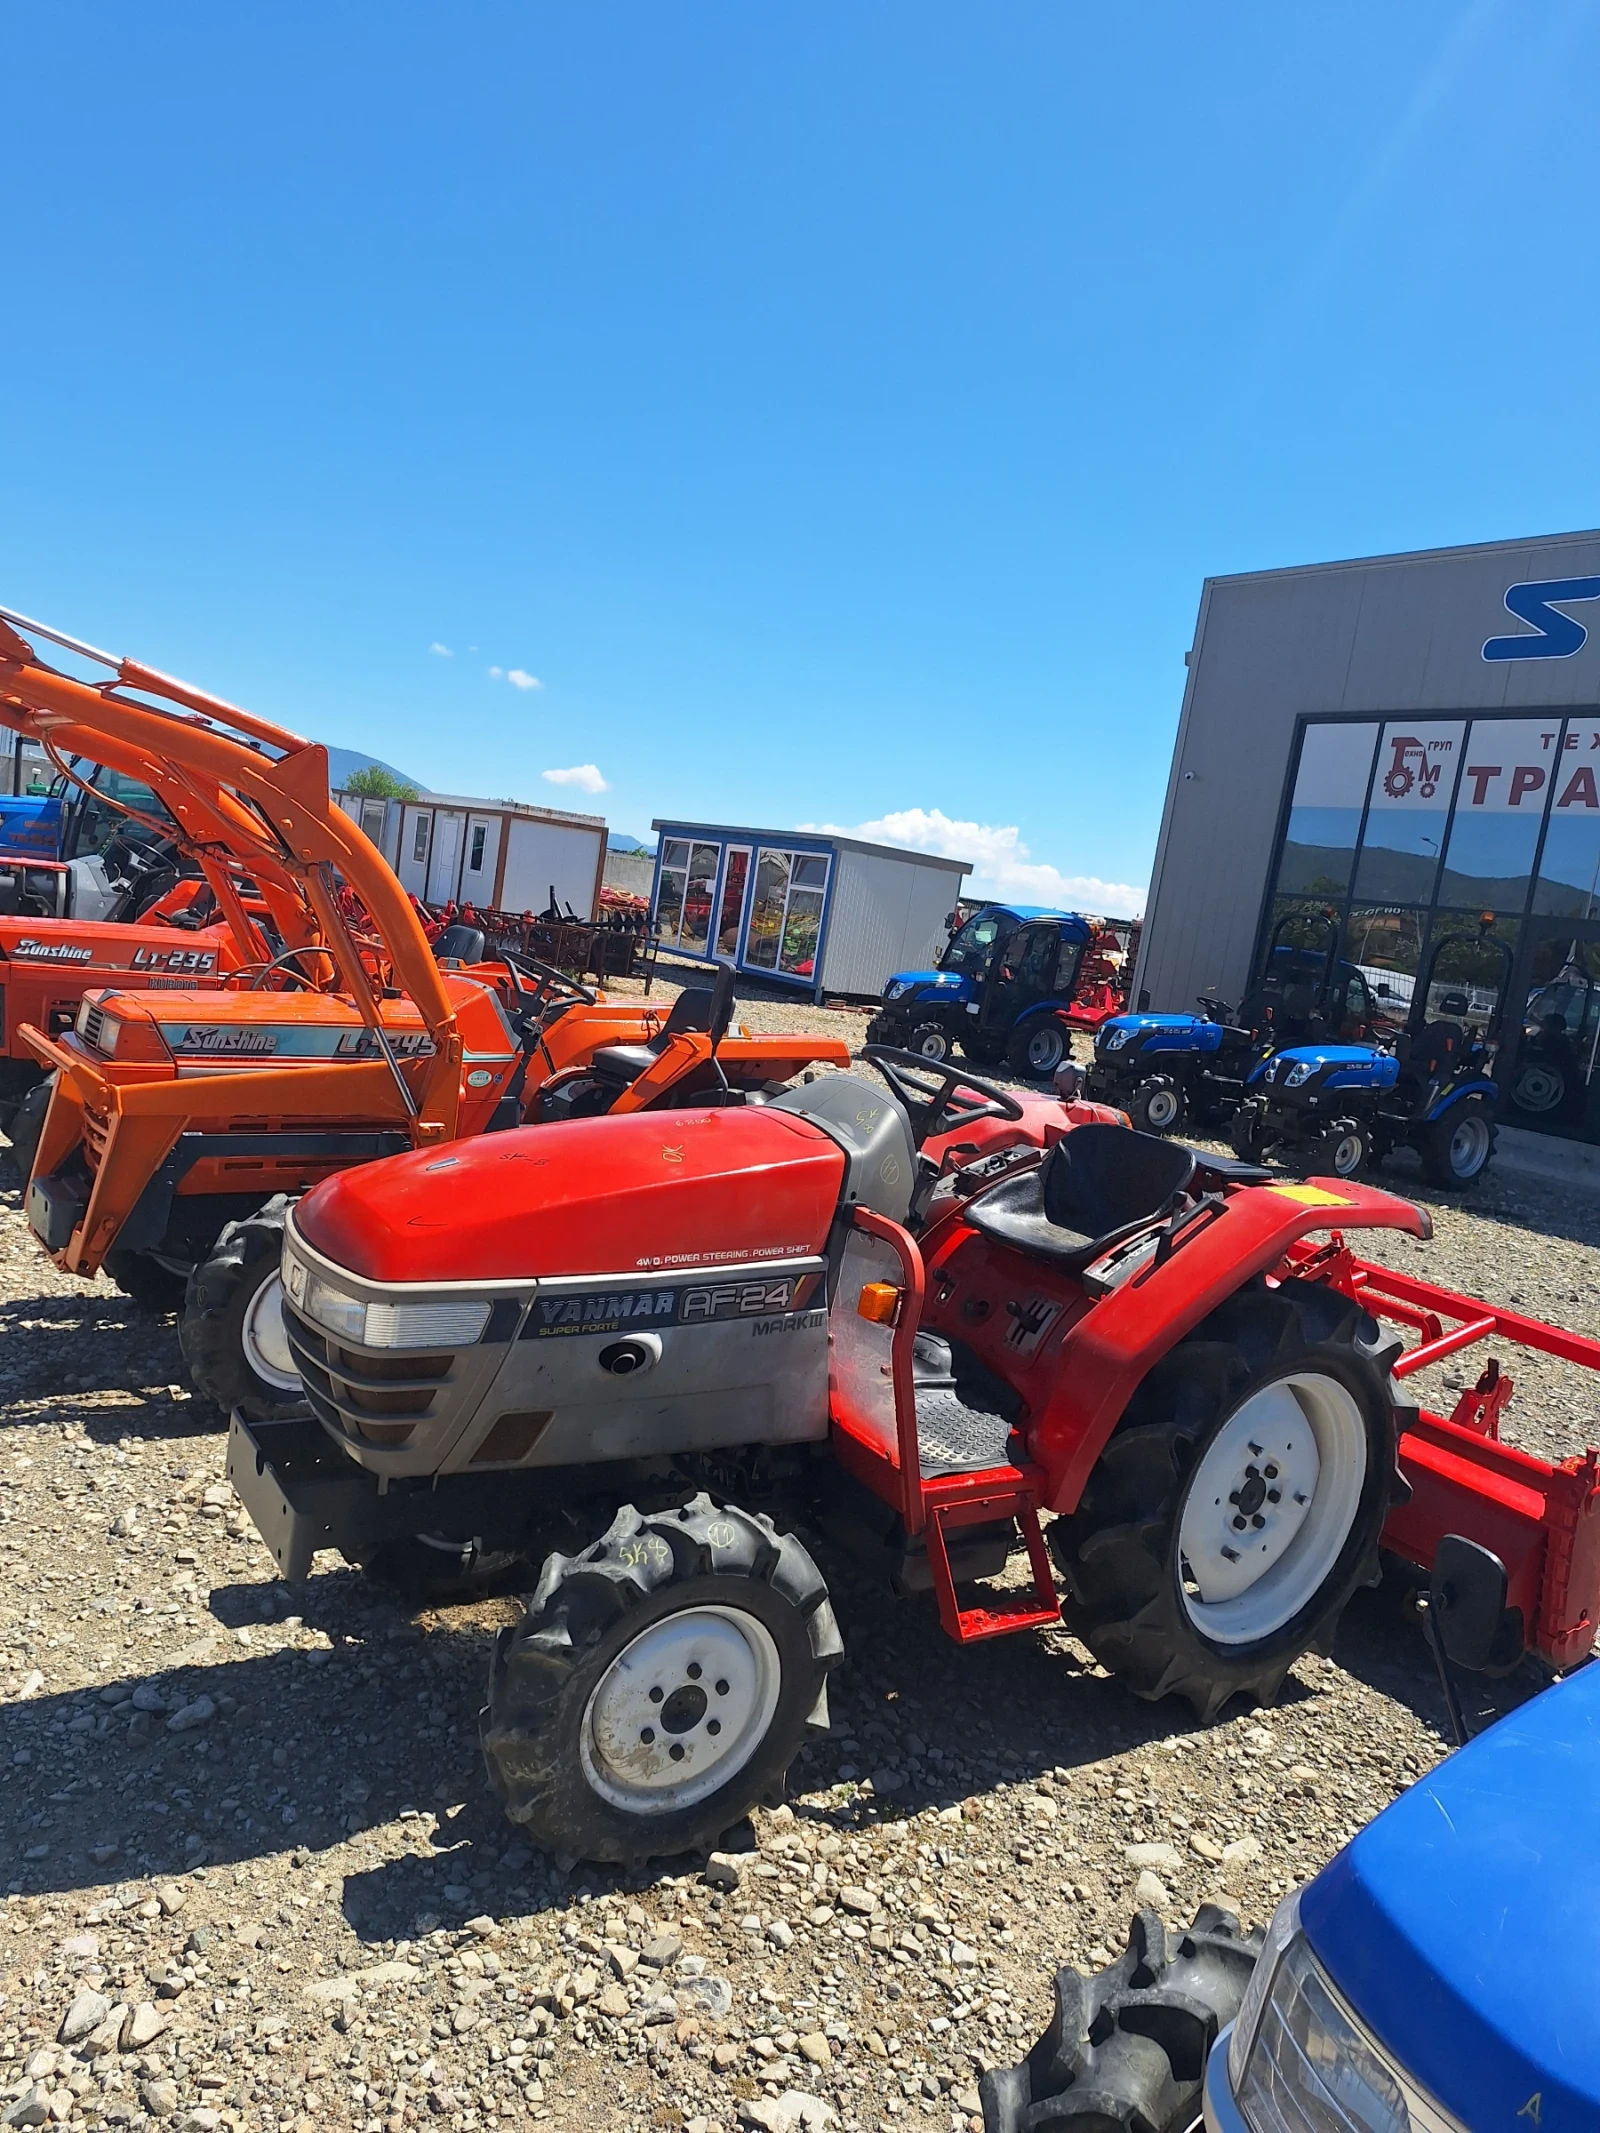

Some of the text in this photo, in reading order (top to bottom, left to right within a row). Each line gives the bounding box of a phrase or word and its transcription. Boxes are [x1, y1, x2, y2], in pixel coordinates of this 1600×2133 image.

[1427, 741, 1453, 751] ГРУП
[1467, 766, 1600, 807] ТРА
[13, 938, 93, 960] Sunshine
[172, 1026, 278, 1051] Sunshine
[664, 1253, 700, 1265] POWER
[753, 1247, 784, 1257] POWER
[786, 1244, 811, 1254] SHIFT
[540, 1291, 675, 1323] YANMAR
[538, 1325, 580, 1336] SUPER
